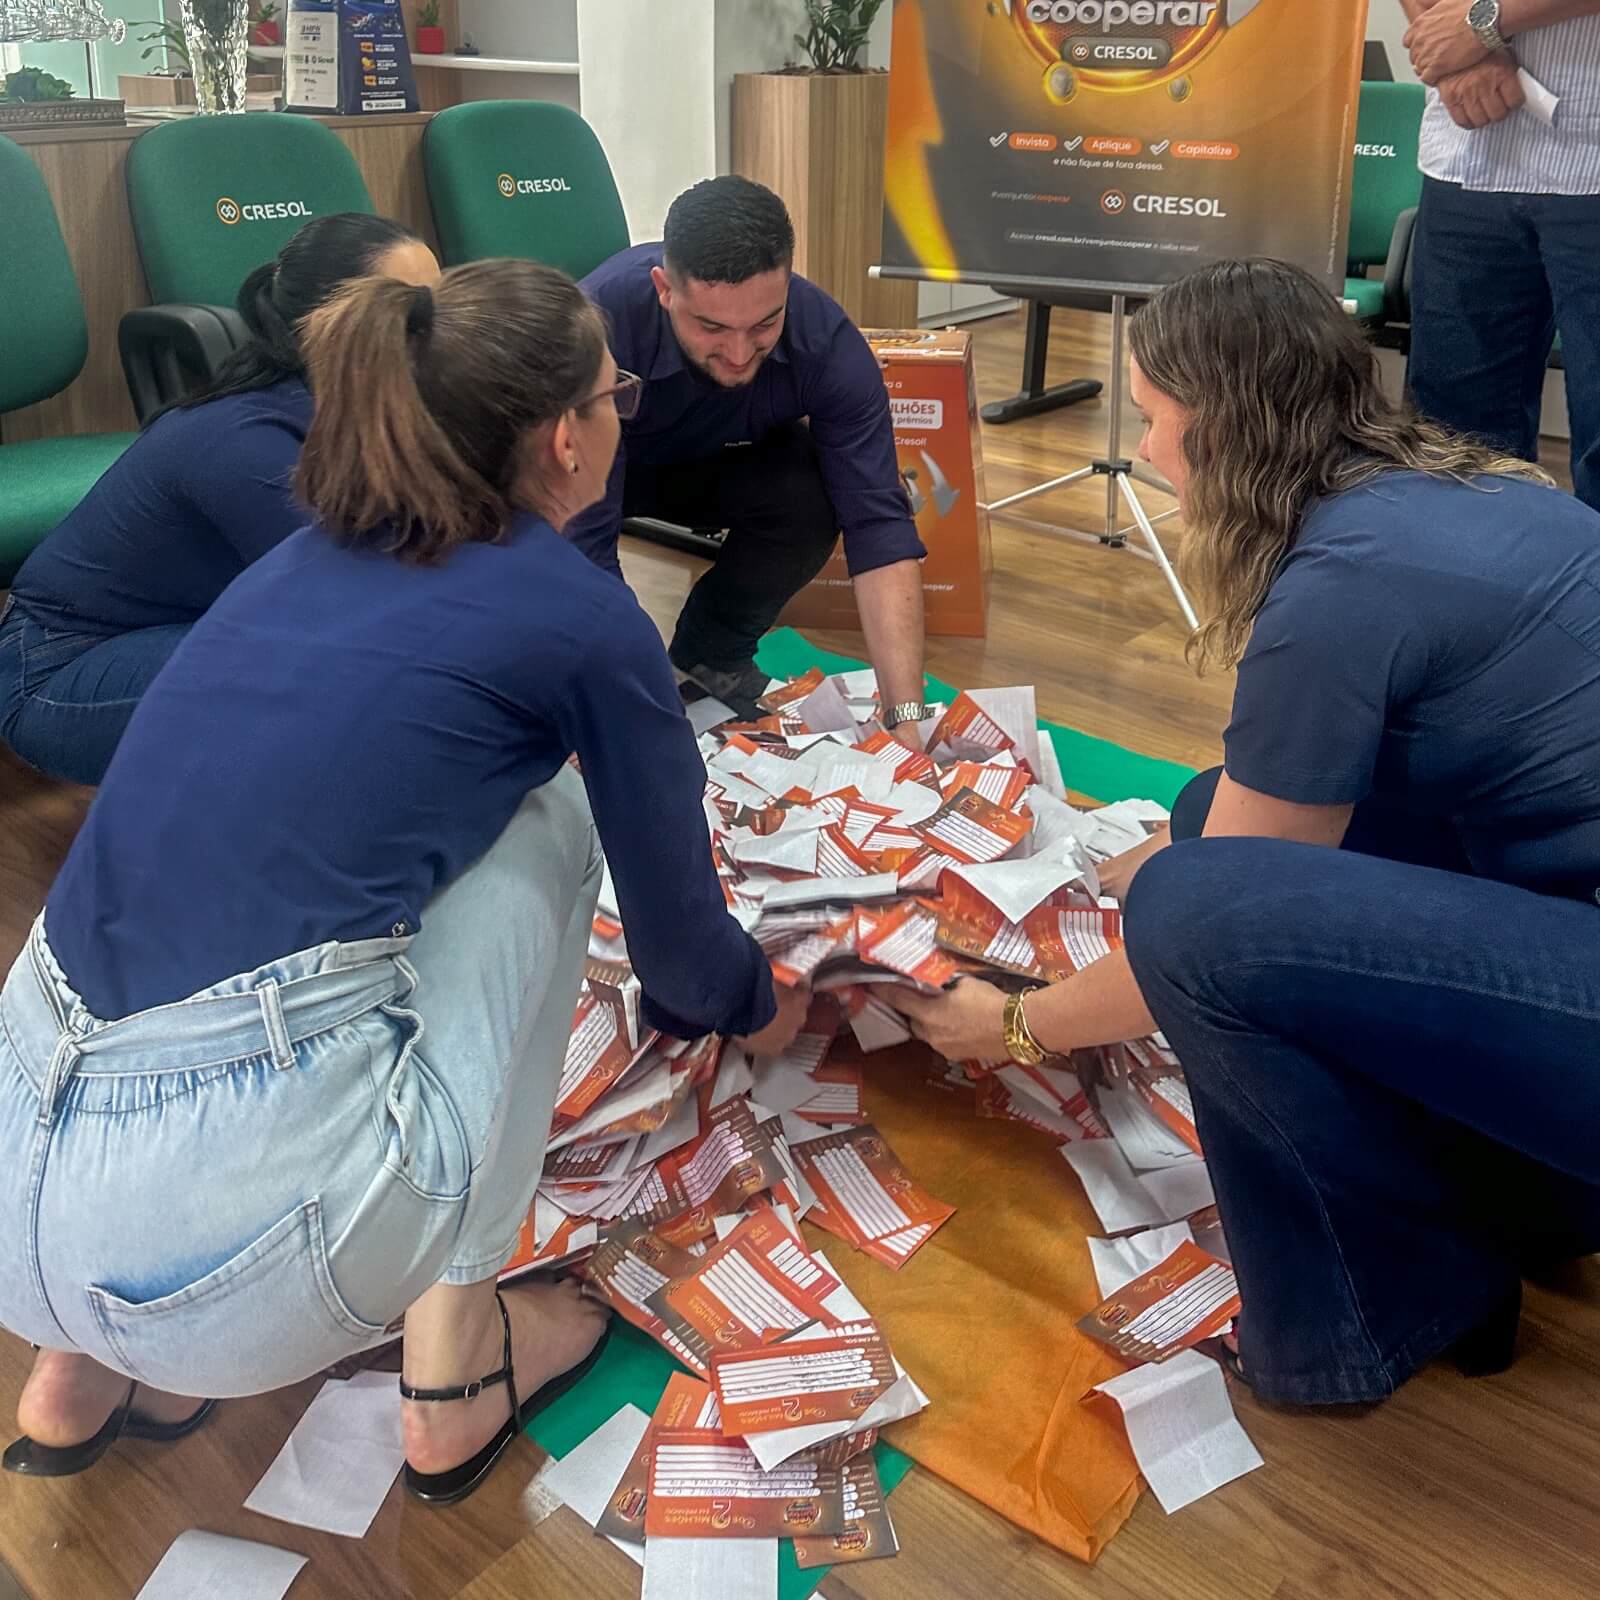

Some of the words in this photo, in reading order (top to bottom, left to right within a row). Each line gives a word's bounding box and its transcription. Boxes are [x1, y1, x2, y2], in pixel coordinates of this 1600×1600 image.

[1026, 0, 1216, 32] cooperar
[1094, 45, 1158, 60] CRESOL
[1016, 136, 1050, 147] Invista
[1091, 139, 1132, 153] Aplique
[1178, 143, 1232, 157] Capitalize
[1353, 143, 1397, 156] RESOL
[1060, 158, 1077, 166] não
[1079, 158, 1100, 168] fique
[1102, 160, 1114, 168] de
[1115, 160, 1134, 169] fora
[1135, 162, 1164, 171] dessa.
[517, 177, 571, 193] CRESOL
[242, 201, 313, 220] CRESOL
[1132, 195, 1227, 217] CRESOL
[890, 402, 936, 415] ILHÕES
[711, 1499, 732, 1529] 2
